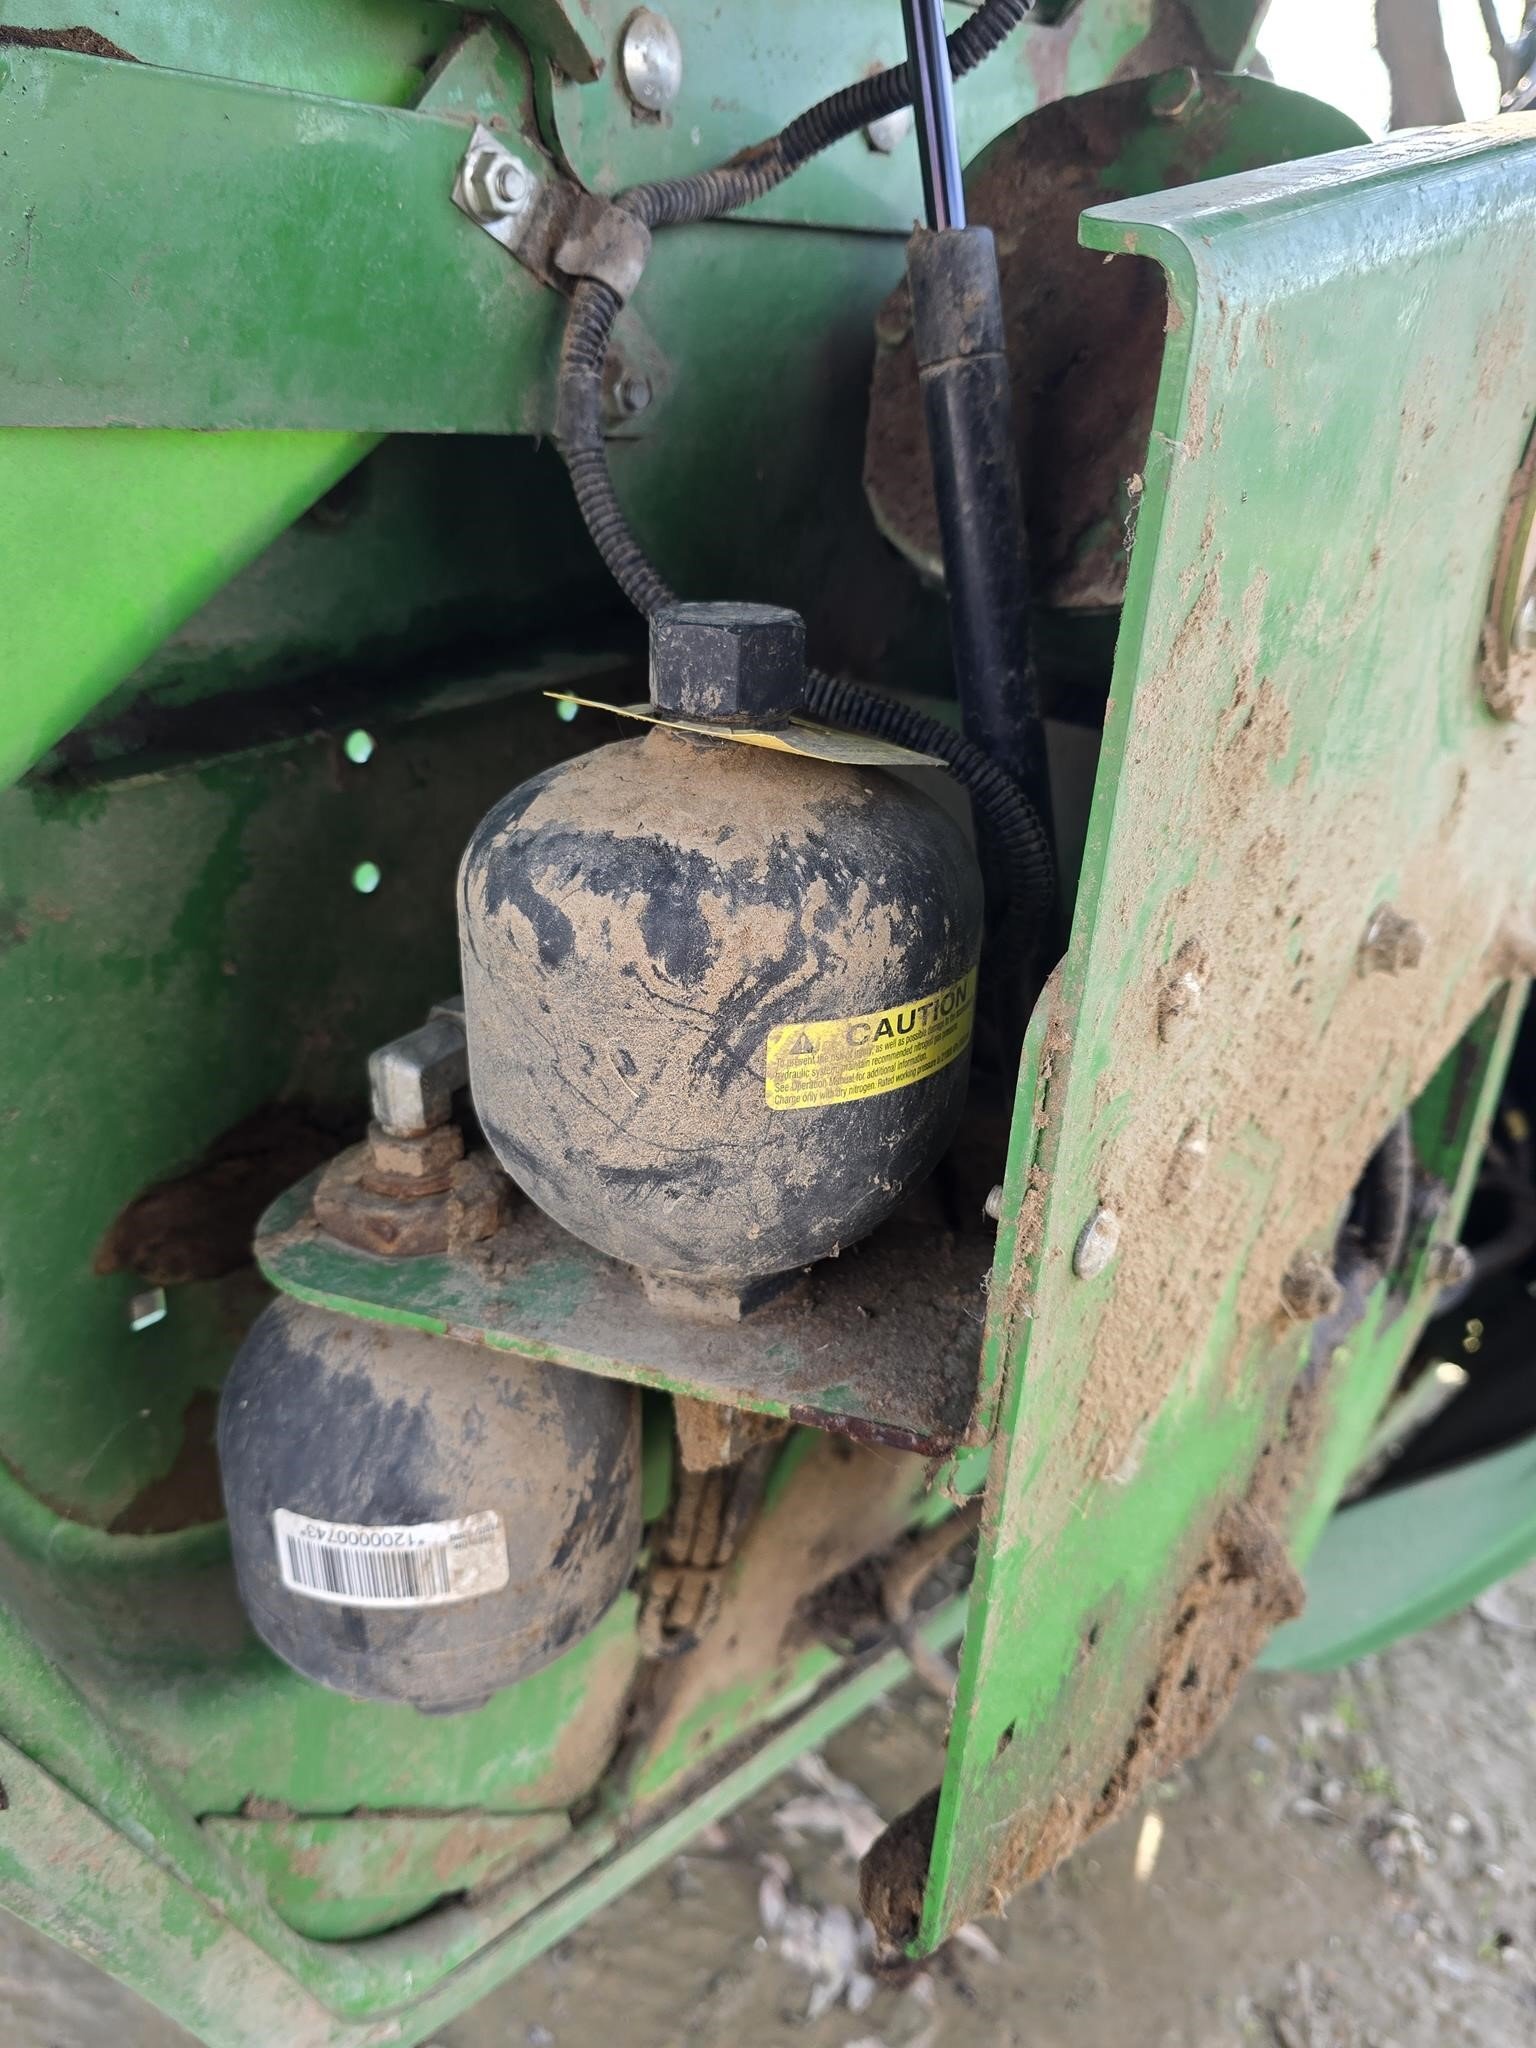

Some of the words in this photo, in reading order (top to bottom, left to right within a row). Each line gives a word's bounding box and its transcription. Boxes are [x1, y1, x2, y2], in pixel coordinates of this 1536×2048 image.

[847, 981, 968, 1047] CAUTION
[876, 1044, 884, 1053] as
[885, 1039, 897, 1051] well
[898, 1037, 905, 1047] as
[775, 1068, 810, 1081] hydraulic
[871, 1047, 913, 1066] recommended
[775, 1082, 789, 1093] See
[791, 1077, 827, 1092] Operation
[856, 1070, 867, 1081] for
[866, 1061, 897, 1080] additional
[775, 1092, 800, 1105] Charge
[802, 1089, 818, 1103] only
[877, 1074, 895, 1088] Rated
[895, 1067, 917, 1082] working
